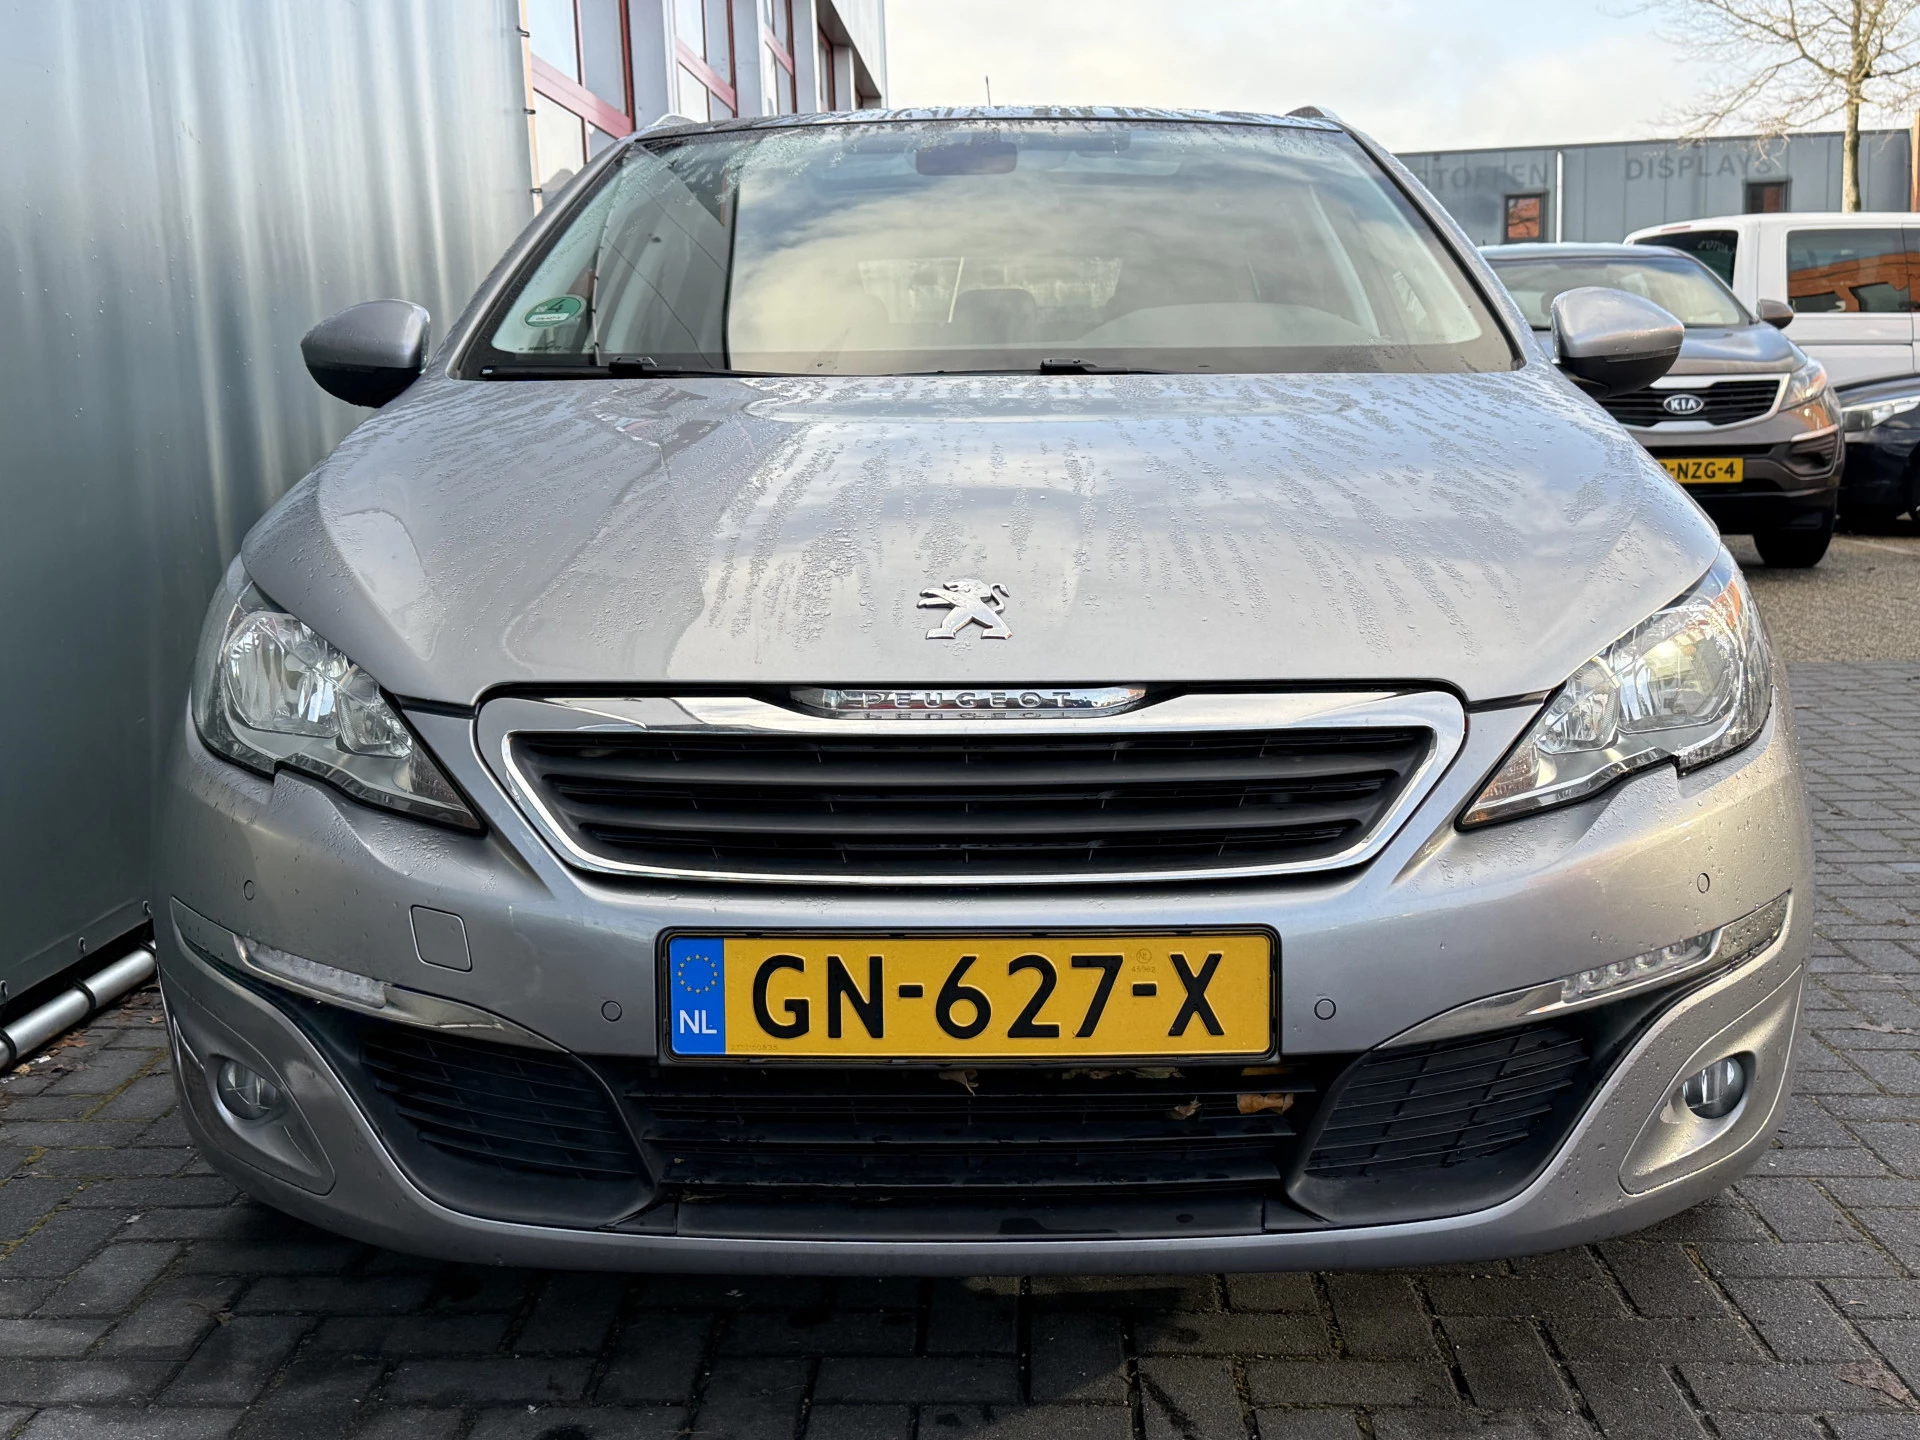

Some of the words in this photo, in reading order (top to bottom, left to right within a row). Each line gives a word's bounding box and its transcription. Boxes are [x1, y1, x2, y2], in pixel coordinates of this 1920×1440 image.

[1625, 153, 1773, 181] DISPLAYS
[1669, 398, 1698, 411] KIA
[862, 691, 1071, 708] PEUGEOT
[753, 953, 1225, 1040] GN-627-X
[679, 1009, 717, 1034] NL
